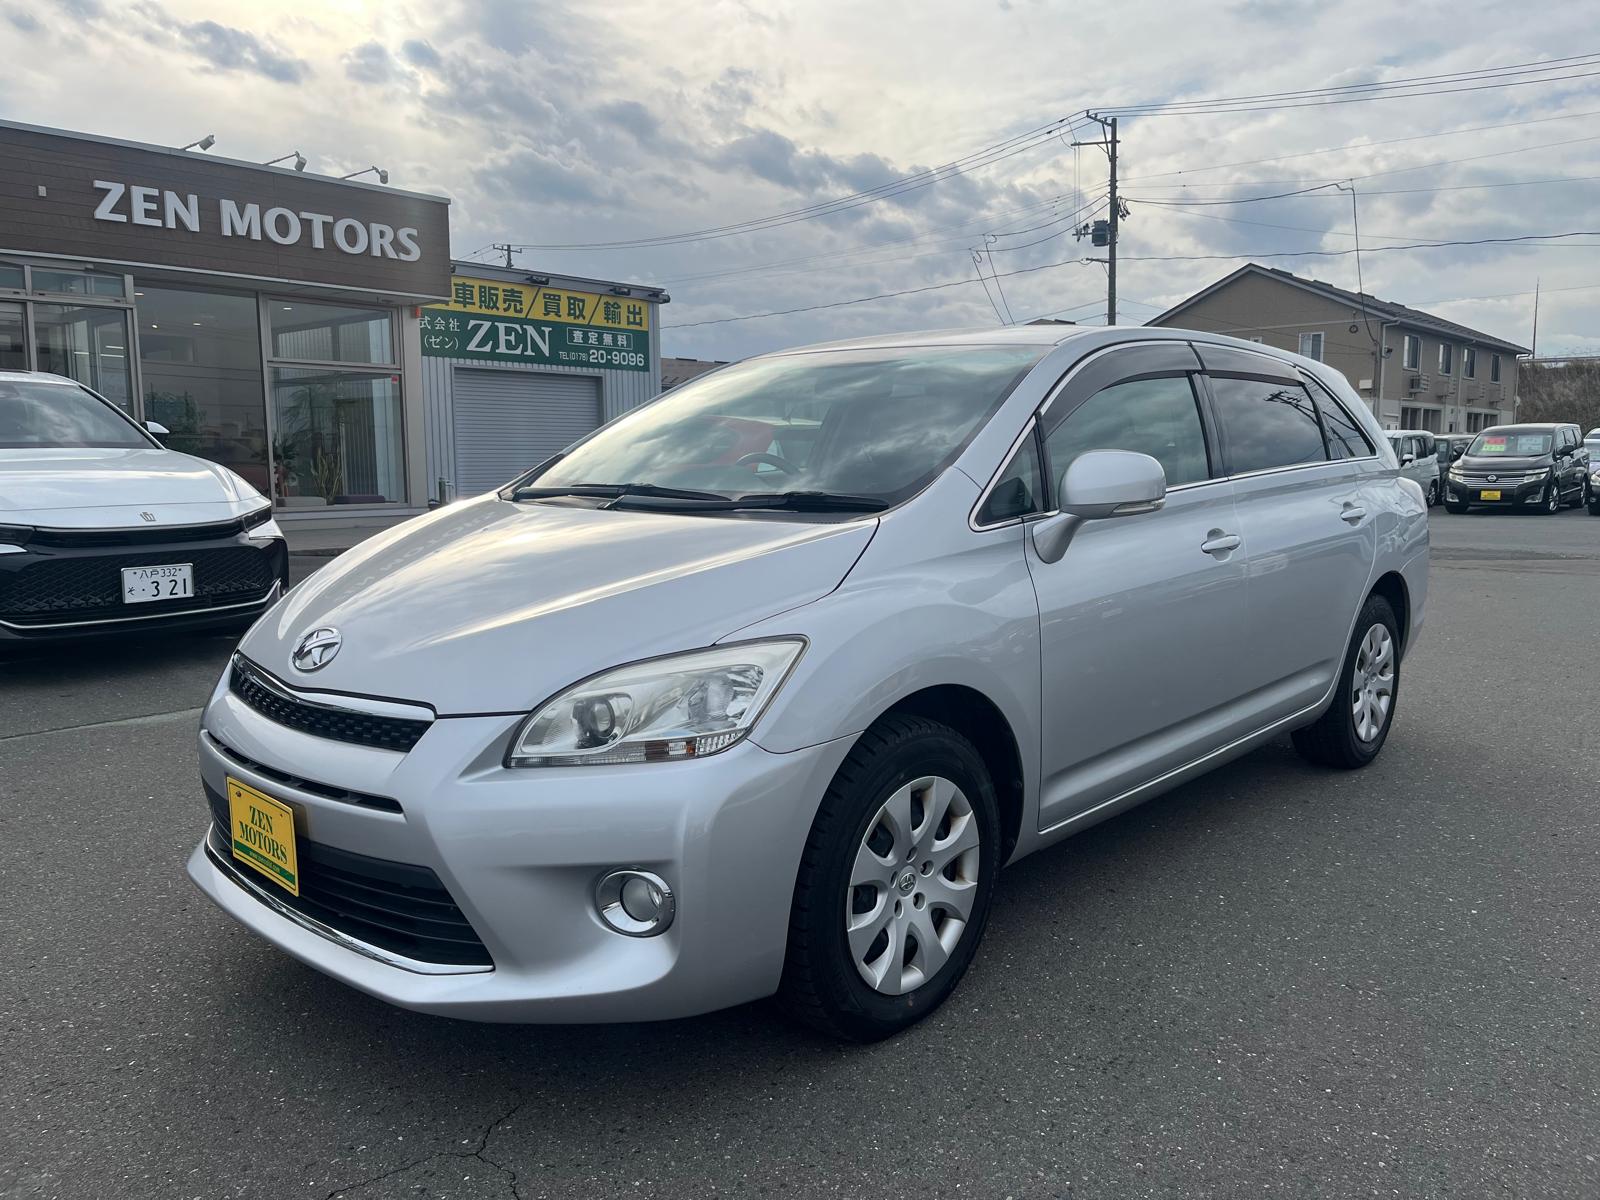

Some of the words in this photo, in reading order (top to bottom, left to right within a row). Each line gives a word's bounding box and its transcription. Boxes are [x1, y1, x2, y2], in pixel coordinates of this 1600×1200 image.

[93, 179, 200, 232] ZEN
[219, 199, 421, 262] MOTORS
[445, 281, 524, 313] 車販売
[543, 293, 586, 320] 買取
[604, 301, 643, 327] 輸出
[466, 319, 552, 357] ZEN
[573, 330, 627, 347] 査定無料
[589, 349, 645, 366] 20-9096
[249, 805, 274, 835] ZEN
[239, 820, 288, 865] MOTORS
